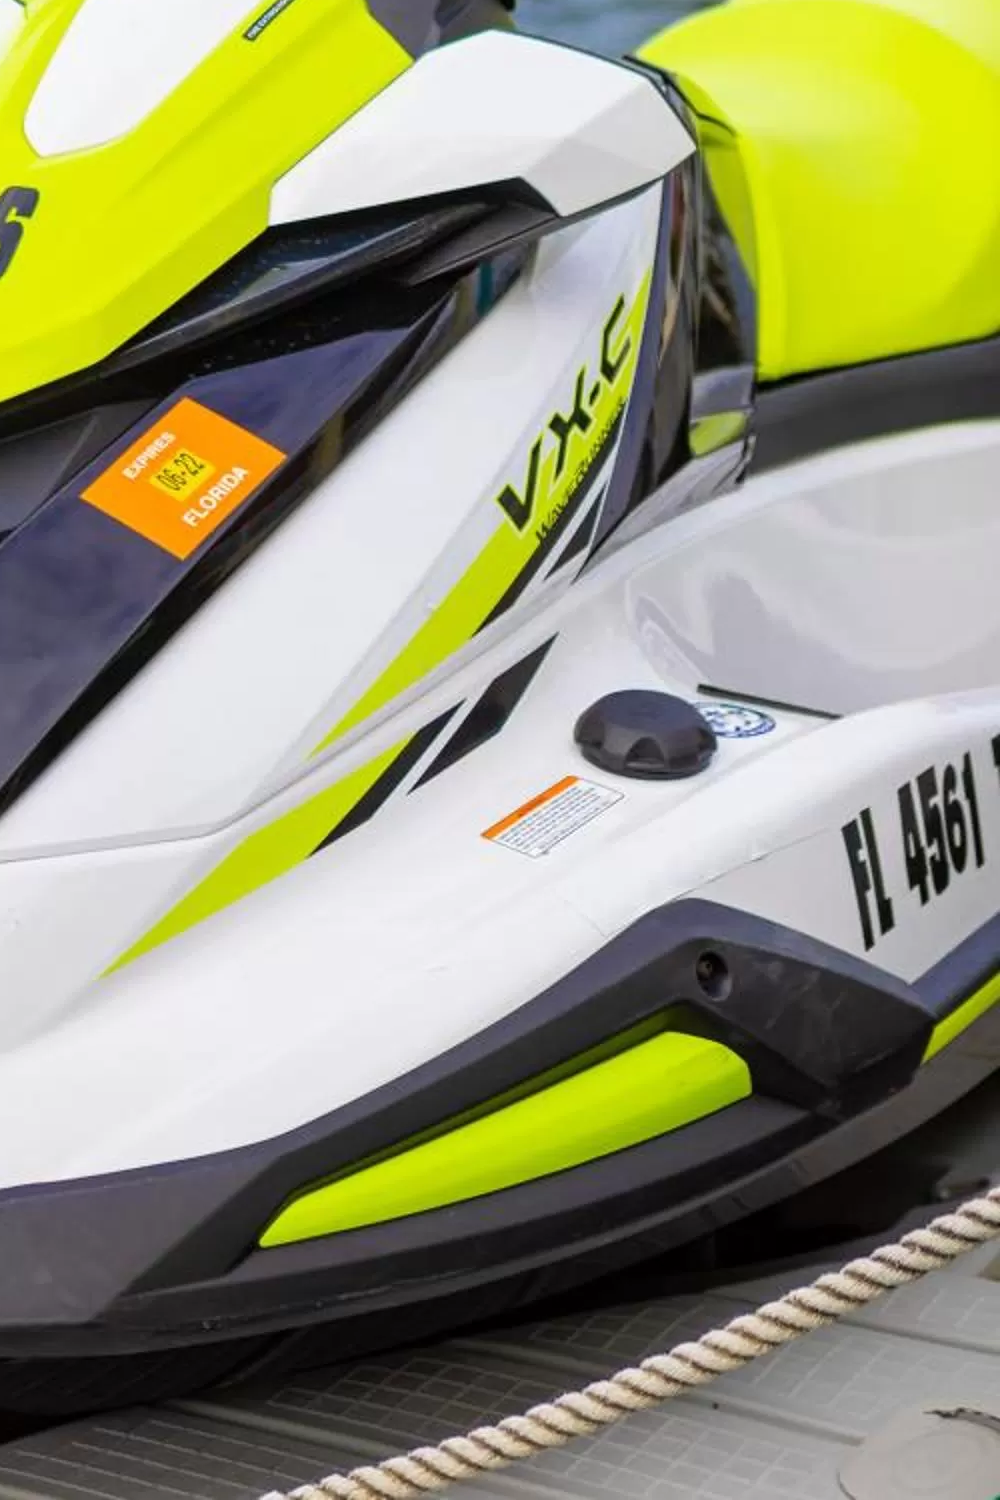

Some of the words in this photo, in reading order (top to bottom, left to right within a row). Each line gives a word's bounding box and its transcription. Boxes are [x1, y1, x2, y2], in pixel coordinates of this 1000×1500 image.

[121, 431, 176, 480] EXPIRES
[496, 291, 631, 533] VX-C
[181, 466, 248, 527] FLORIDA
[840, 806, 896, 953] FL
[896, 750, 986, 907] 4561
